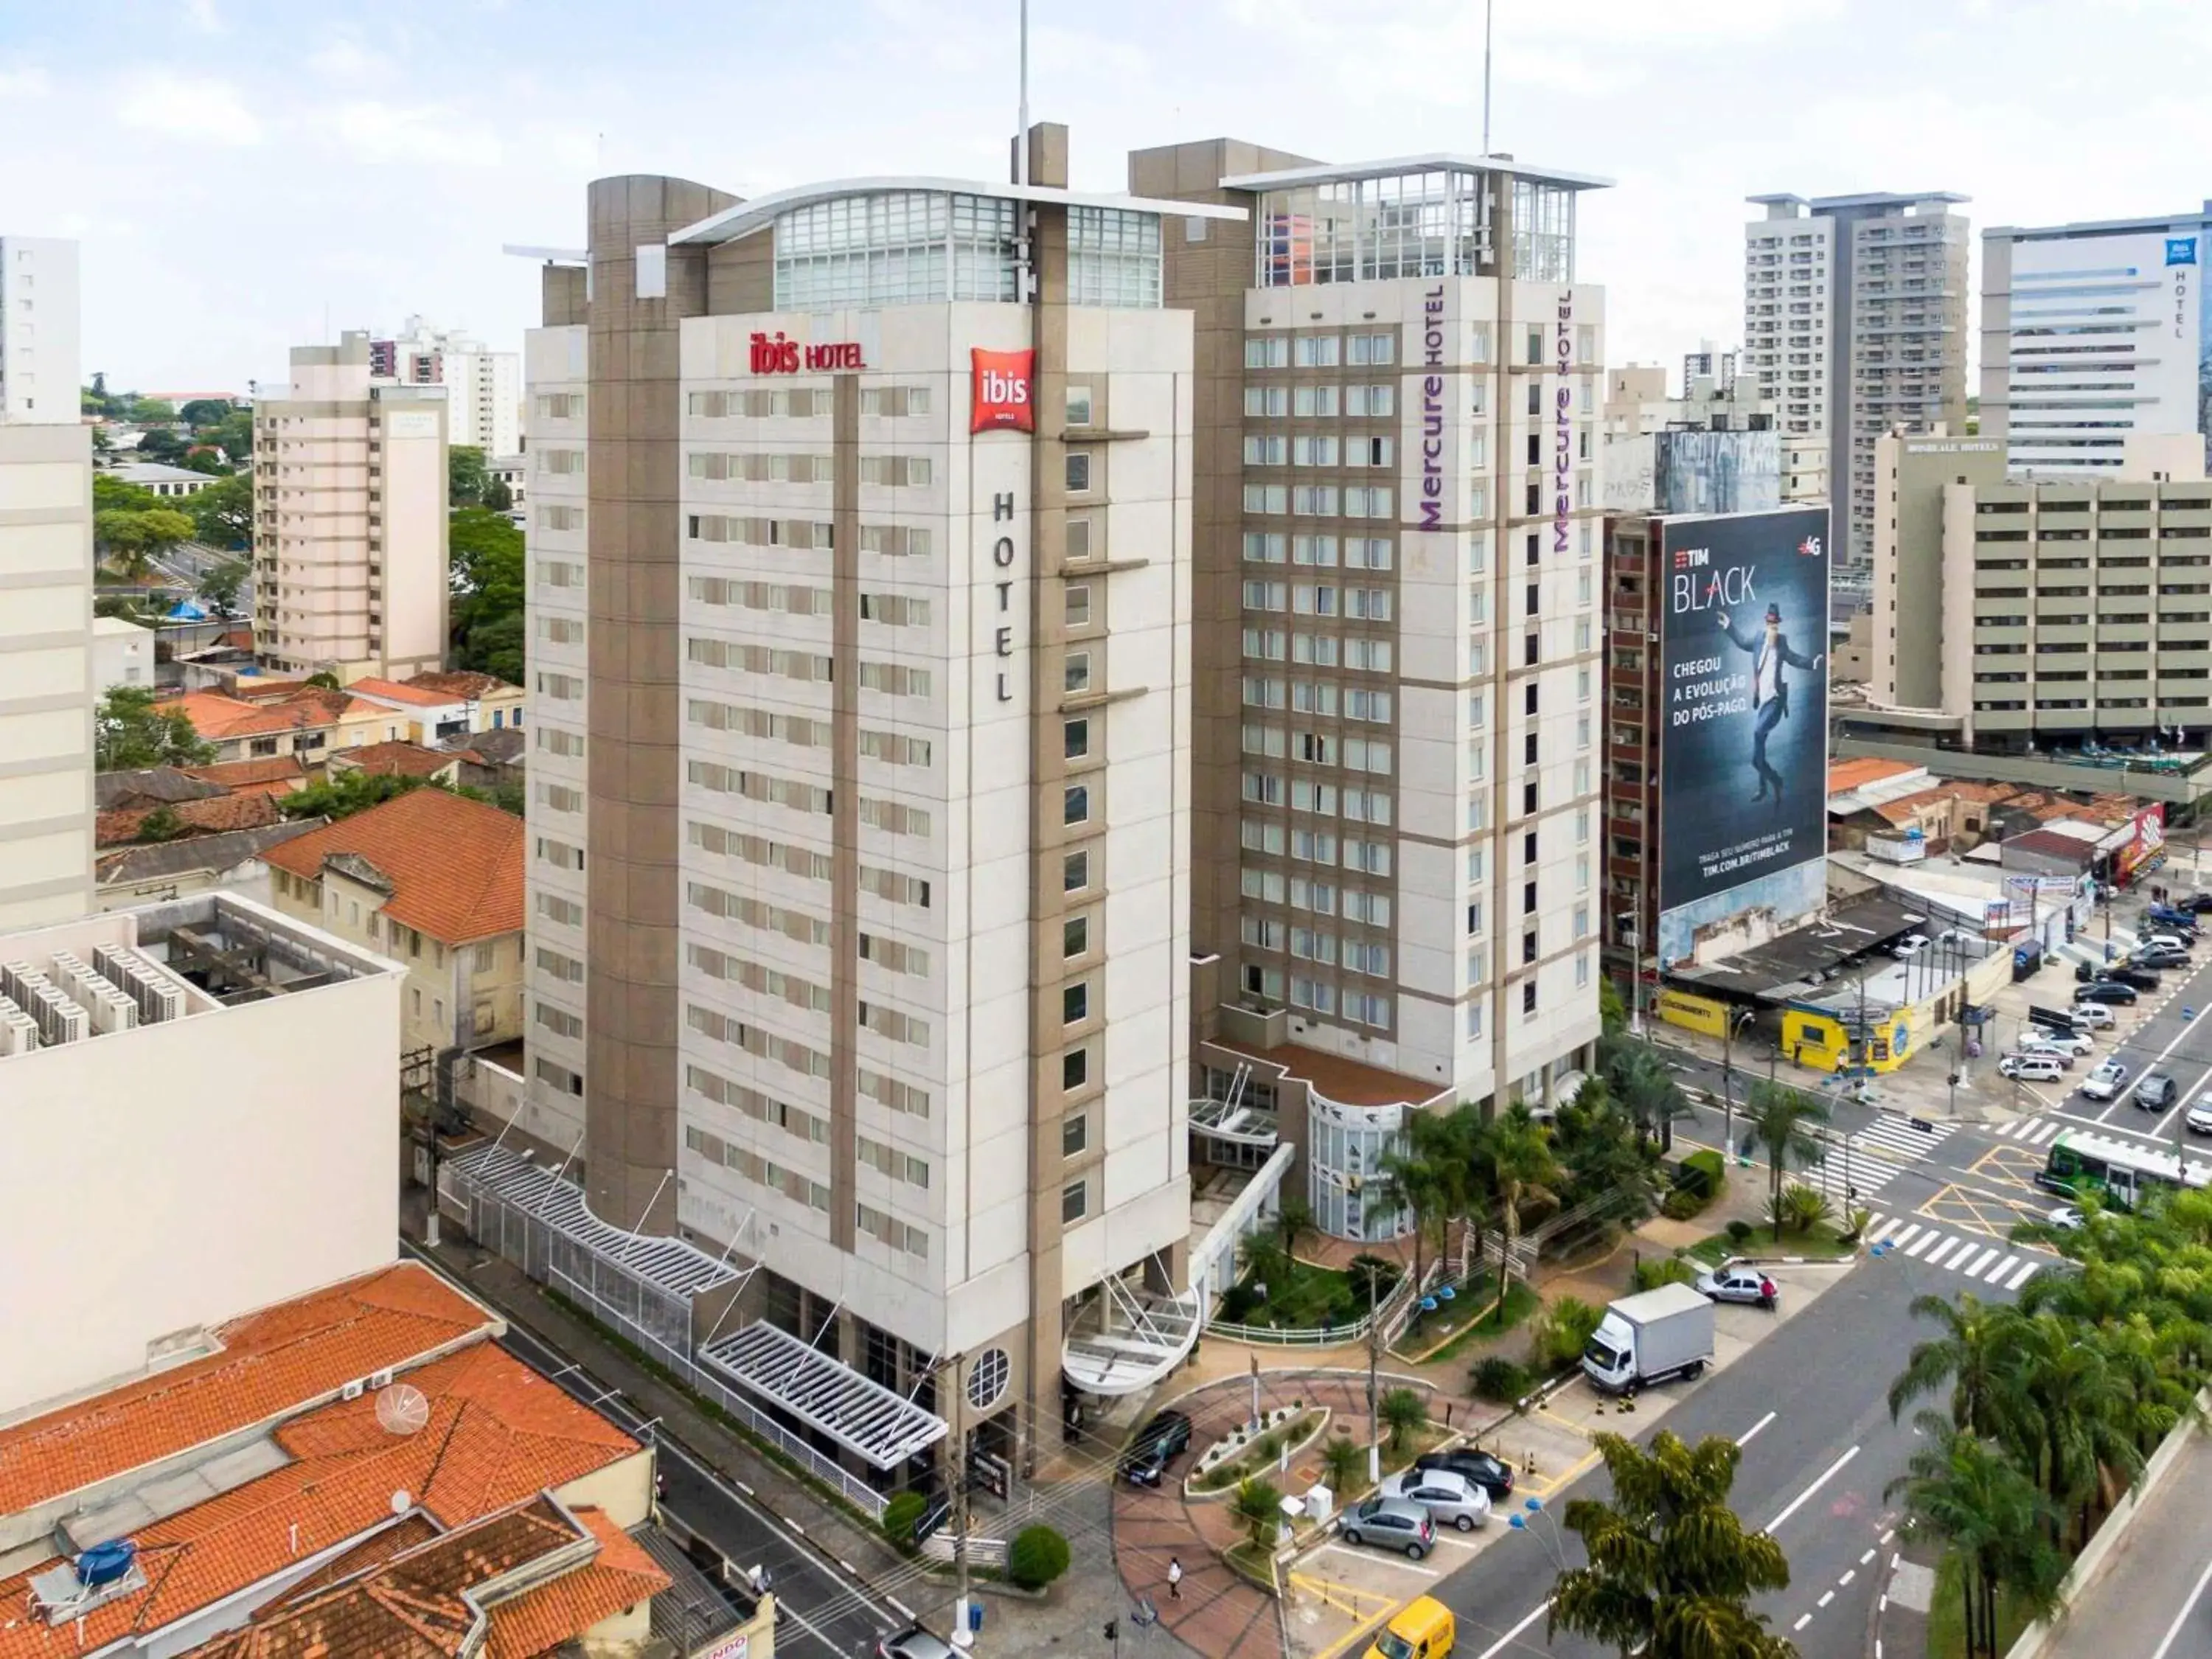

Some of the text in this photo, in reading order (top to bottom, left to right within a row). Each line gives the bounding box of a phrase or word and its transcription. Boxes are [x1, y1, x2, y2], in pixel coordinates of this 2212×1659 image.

[2175, 271, 2185, 338] HOTEL
[751, 331, 867, 375] ibis HOTEL
[982, 369, 1027, 404] ibis
[1418, 285, 1443, 532] Mercure HOTEL
[1554, 290, 1571, 553] Mercure HOTEL
[1687, 548, 1709, 567] TIM
[1802, 535, 1821, 555] 4G
[994, 492, 1014, 702] HOTEL
[1674, 565, 1756, 613] BLACK
[1673, 656, 1722, 678] CHEGOU
[1673, 673, 1746, 703] A EVOLUÇÃO
[1673, 698, 1747, 726] DO PÓS-PAGO
[1703, 841, 1790, 878] TIM.COM.BR/TIMBLACK
